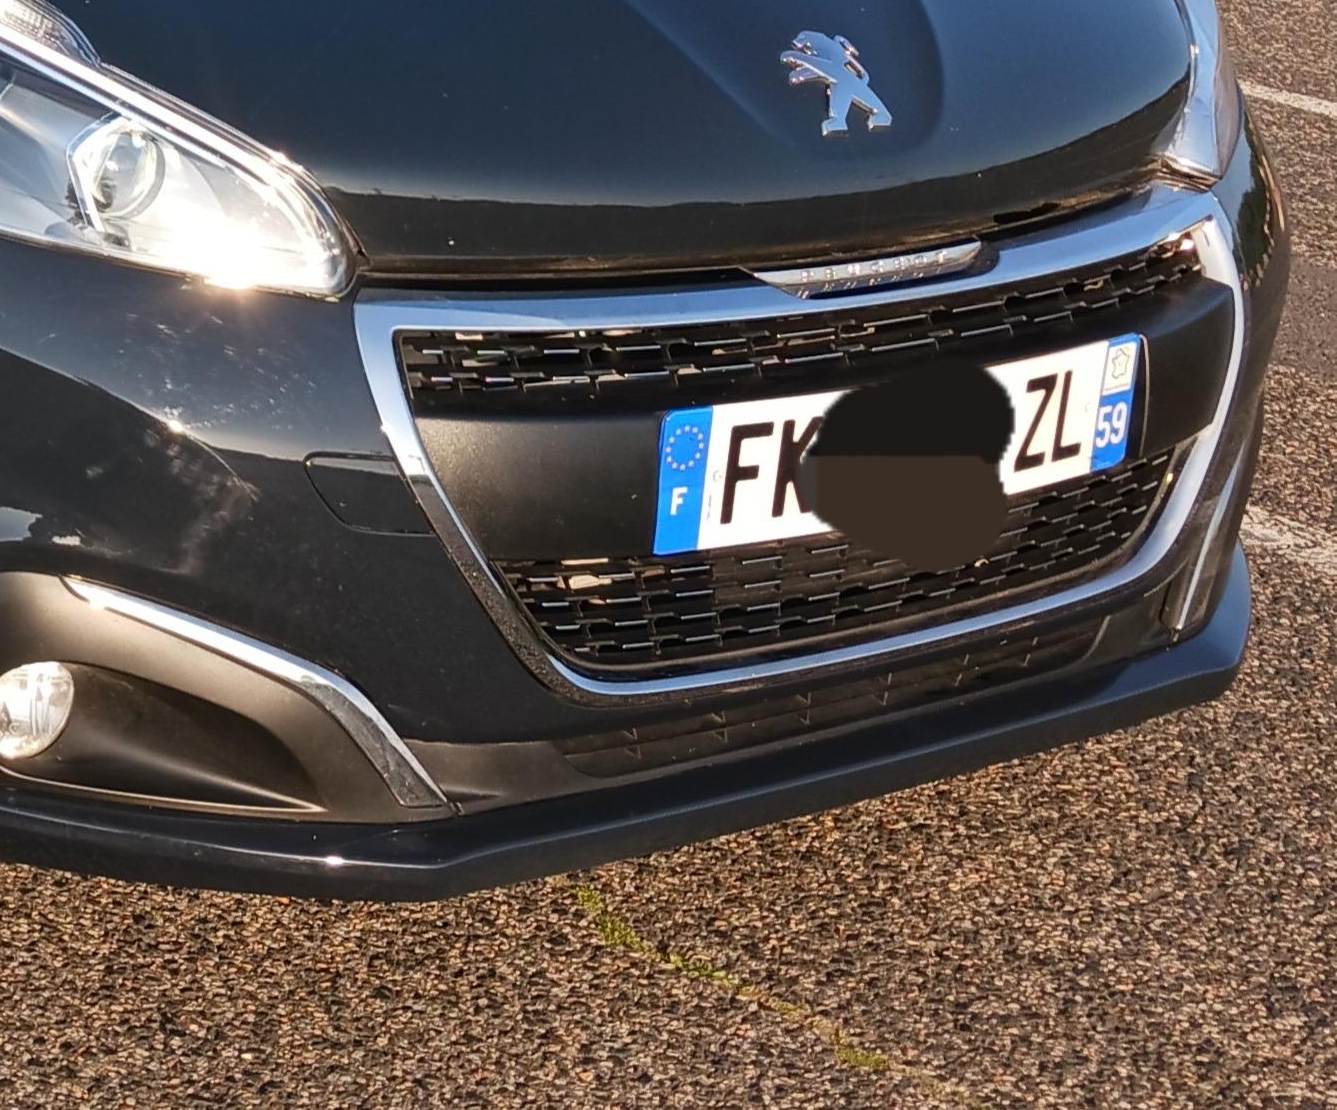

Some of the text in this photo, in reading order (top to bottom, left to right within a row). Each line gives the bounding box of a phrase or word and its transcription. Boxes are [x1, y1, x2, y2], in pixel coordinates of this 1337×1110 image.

[720, 370, 1081, 525] FK ZL
[1096, 401, 1128, 448] 59
[670, 486, 688, 516] F
